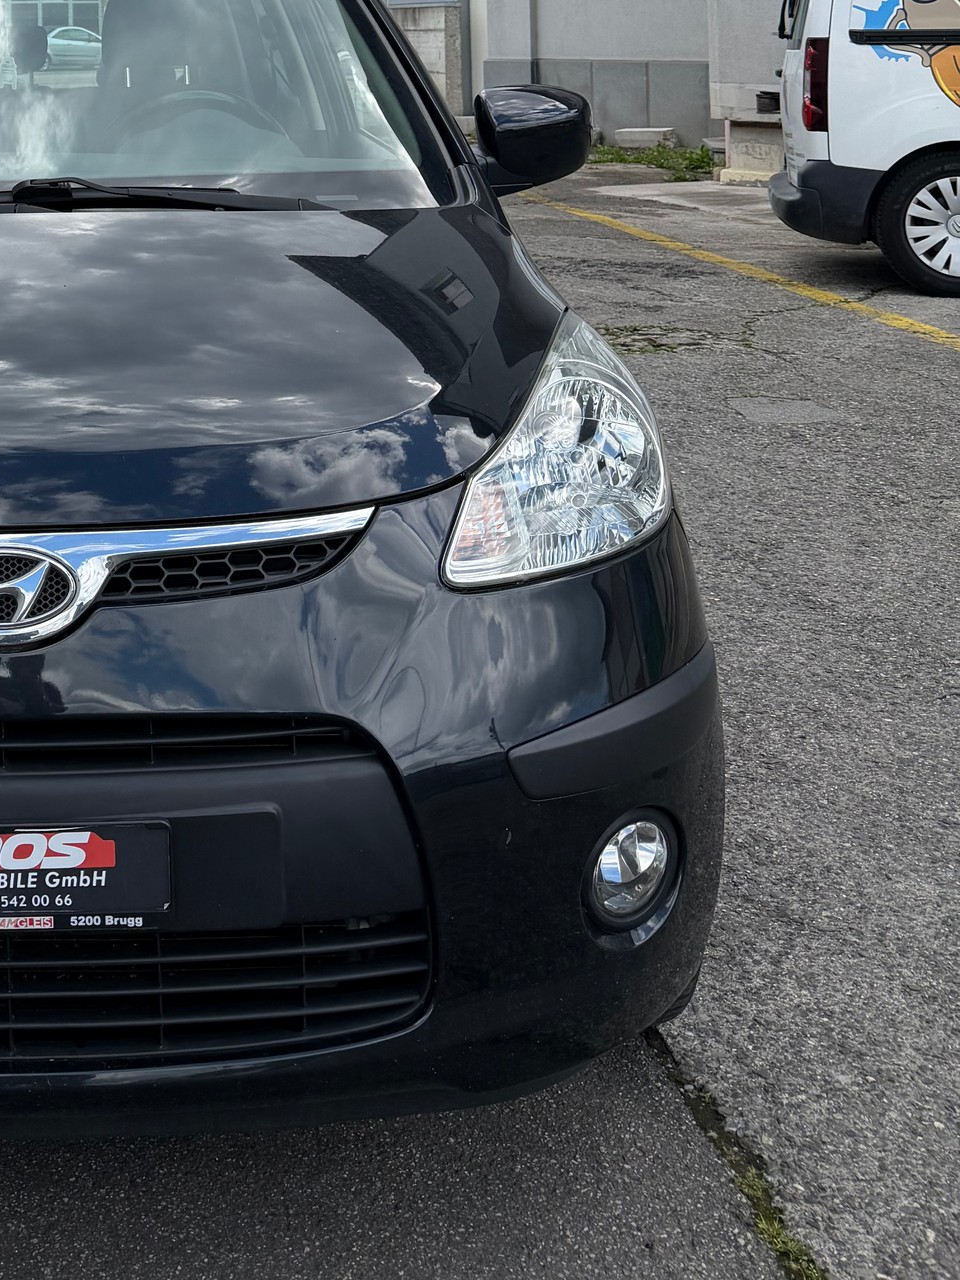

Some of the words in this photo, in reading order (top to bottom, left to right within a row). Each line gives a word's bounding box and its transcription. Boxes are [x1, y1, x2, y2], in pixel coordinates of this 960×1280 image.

[44, 870, 106, 888] GmbH
[1, 895, 27, 907] 542
[32, 894, 50, 907] 00
[55, 894, 72, 906] 66
[70, 916, 101, 926] 5200
[105, 915, 143, 927] Brugg
